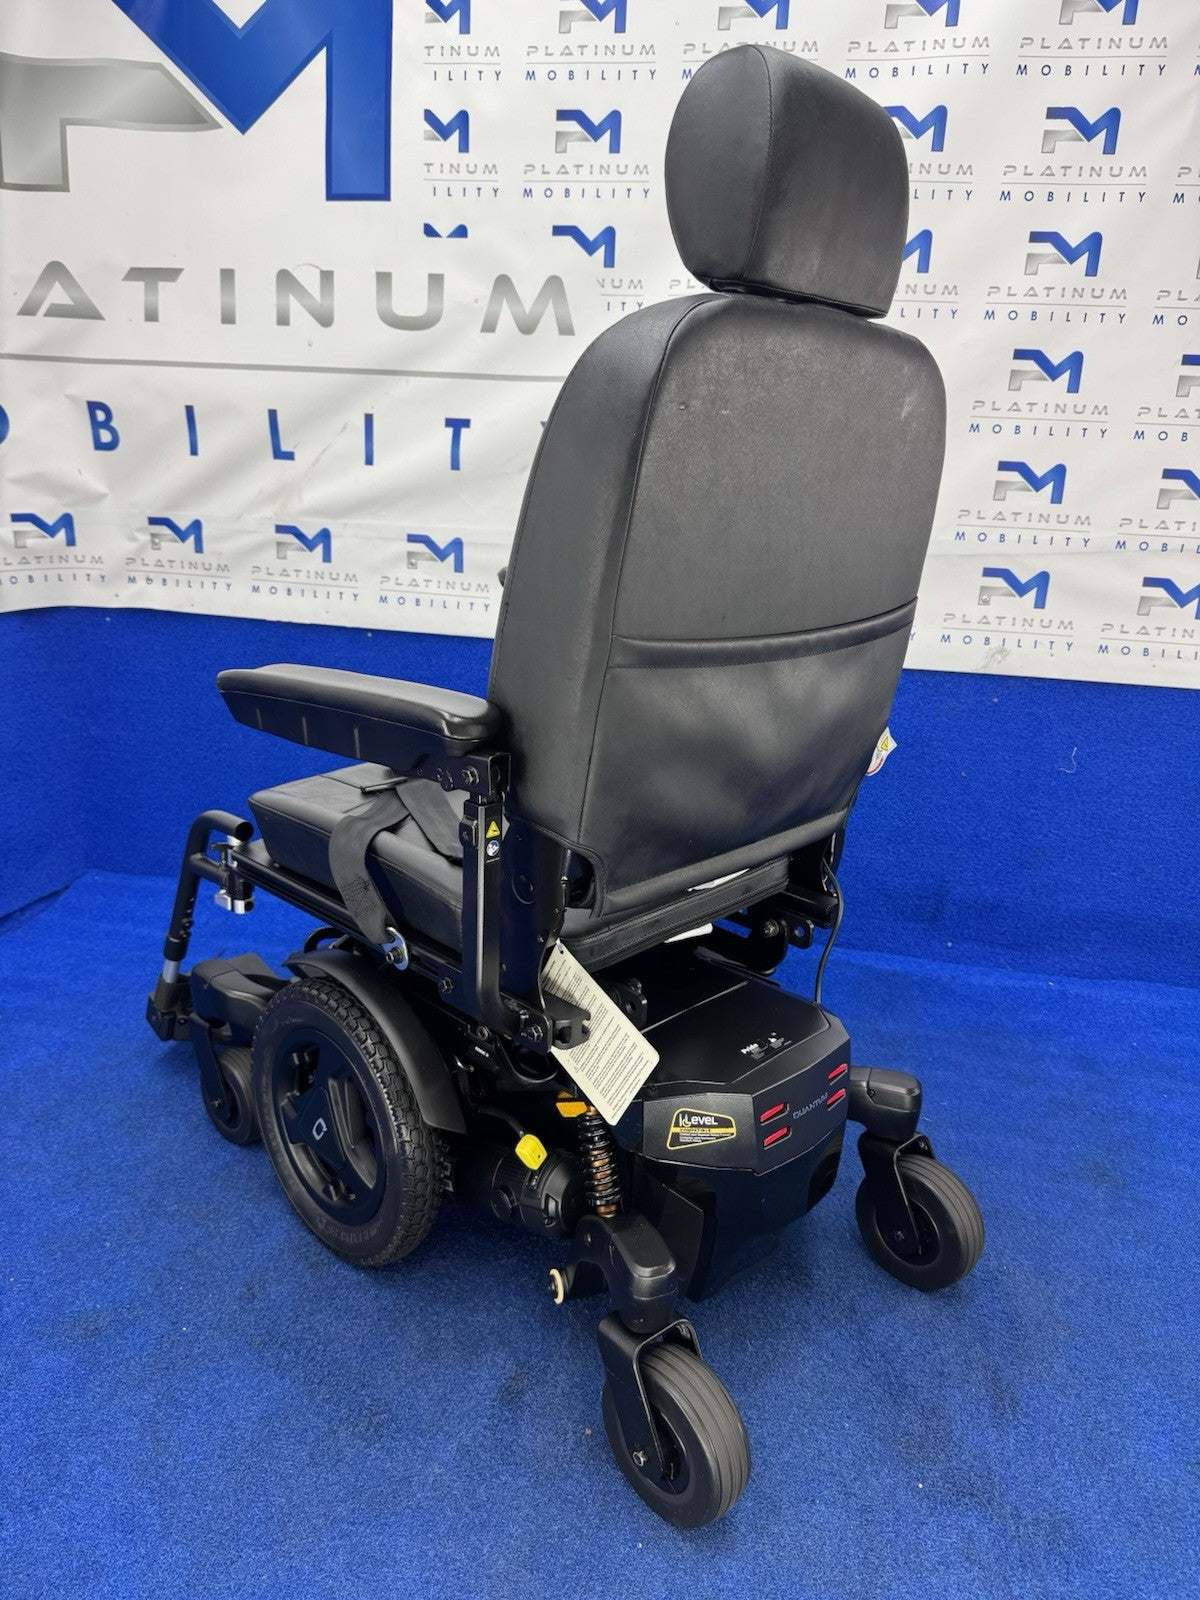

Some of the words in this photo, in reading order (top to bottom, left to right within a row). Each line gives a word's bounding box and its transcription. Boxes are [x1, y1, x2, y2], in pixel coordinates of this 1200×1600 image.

[527, 44, 656, 56] PLATINUM
[847, 37, 990, 54] PLATINUM
[1019, 36, 1168, 50] PLATINUM
[525, 70, 656, 81] MOBILITY
[845, 63, 989, 79] MOBILITY
[1016, 64, 1166, 76] MOBILITY
[524, 164, 649, 175] PLATINUM
[1003, 165, 1147, 177] PLATINUM
[523, 188, 649, 198] MOBILITY
[1000, 191, 1146, 202] MOBILITY
[987, 286, 1127, 300] PLATINUM
[984, 310, 1126, 324] MOBILITY
[971, 400, 1109, 416] PLATINUM
[969, 423, 1108, 439] MOBILITY
[957, 509, 1091, 526] PLATINUM
[954, 532, 1091, 547] MOBILITY
[126, 557, 230, 573] PLATINUM
[251, 566, 358, 582] PLATINUM
[127, 575, 232, 591] MOBILITY
[380, 576, 490, 593] PLATINUM
[252, 585, 359, 601] MOBILITY
[379, 596, 490, 612] MOBILITY
[943, 613, 1075, 631] PLATINUM
[940, 634, 1074, 652] MOBILITY
